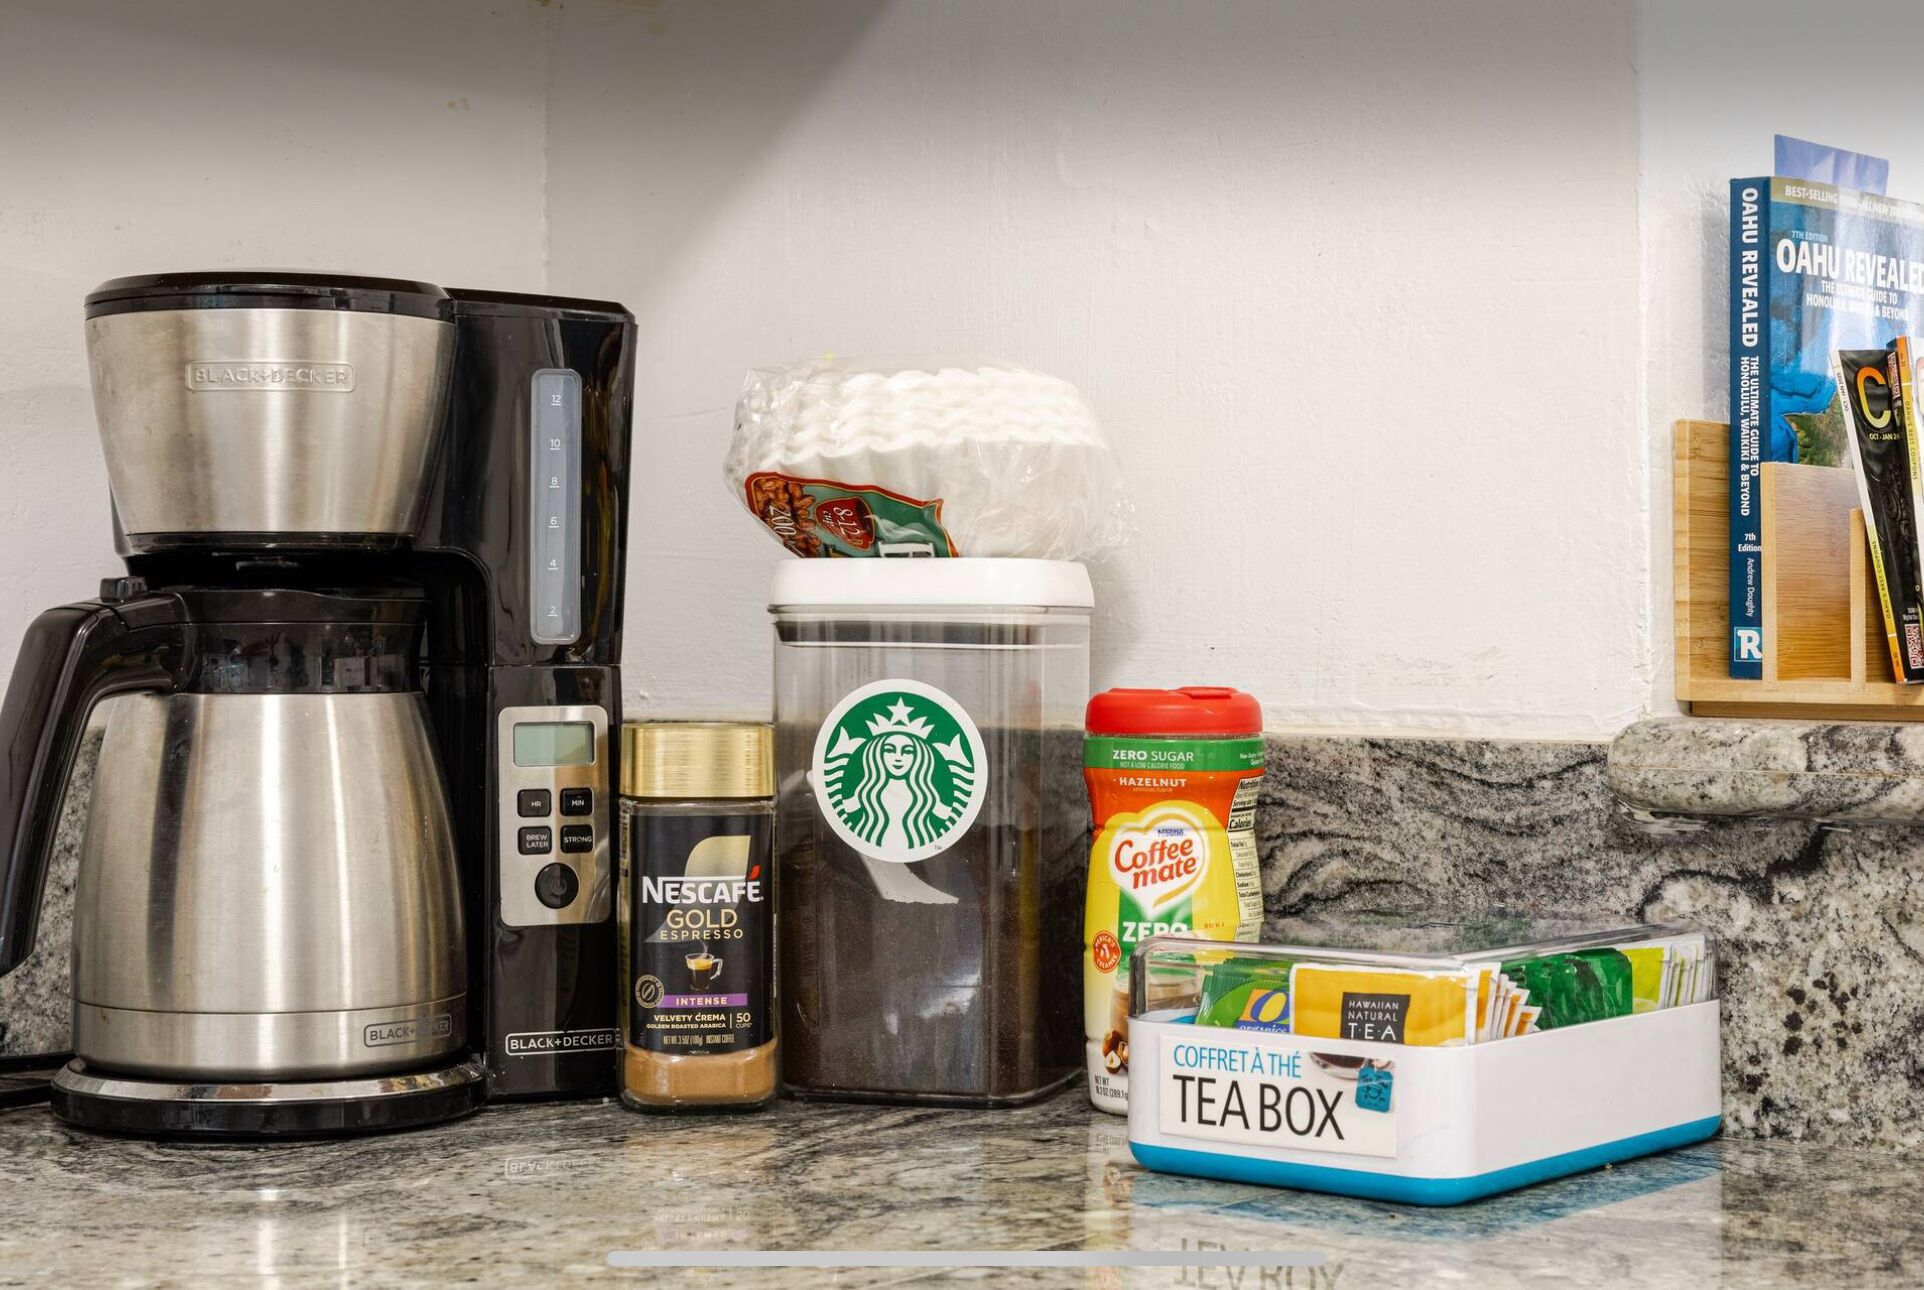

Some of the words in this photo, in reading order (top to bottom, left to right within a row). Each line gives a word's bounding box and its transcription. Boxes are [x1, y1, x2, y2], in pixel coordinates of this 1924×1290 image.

[1741, 187, 1758, 244] OAHU
[1776, 238, 1840, 279] OAHU
[1741, 249, 1758, 348] REVEALED
[1821, 280, 1836, 293] THE
[1888, 292, 1898, 305] TO
[1881, 306, 1910, 321] BEYOND
[1750, 355, 1759, 376] THE
[194, 368, 348, 384] BLACK+DECKER
[1740, 356, 1750, 416] HONOLULU,
[551, 394, 562, 404] 12
[1750, 378, 1759, 427] ULTIMATE
[550, 438, 561, 448] 10
[1740, 418, 1750, 460] WAIKIKI
[1750, 428, 1759, 461] GUIDE
[1740, 463, 1750, 472] &
[1750, 463, 1759, 477] TO
[551, 477, 558, 486] 8
[1740, 474, 1750, 516] BEYOND
[550, 516, 557, 526] 6
[1744, 533, 1756, 541] 7th
[1738, 543, 1762, 552] Edition
[550, 559, 557, 567] 4
[1747, 557, 1755, 585] Andrew
[550, 605, 556, 614] 2
[1745, 587, 1755, 618] Doughty
[1737, 629, 1762, 660] R
[1112, 750, 1148, 761] ZERO
[1151, 750, 1194, 762] SUGAR
[1119, 777, 1188, 788] HAZELNUT
[526, 841, 549, 849] LATER
[564, 836, 592, 844] STRONG
[1114, 838, 1194, 873] Coffee
[1133, 856, 1197, 890] mate
[642, 865, 762, 904] NESCAFÉ
[666, 908, 738, 929] GOLD
[660, 929, 744, 941] ESPRESSO
[676, 997, 728, 1006] INTENSE
[1349, 1000, 1399, 1010] HAWAIIAN
[653, 1014, 693, 1022] VELVETY
[735, 1012, 751, 1023] 50
[1348, 1011, 1398, 1022] NATURAL
[510, 1033, 613, 1050] BLACK+DECKER
[1174, 1044, 1248, 1073] COFFRET
[1251, 1047, 1265, 1074] À
[1267, 1050, 1302, 1078] THÉ
[1173, 1074, 1250, 1130] TEA
[1259, 1083, 1345, 1140] BOX
